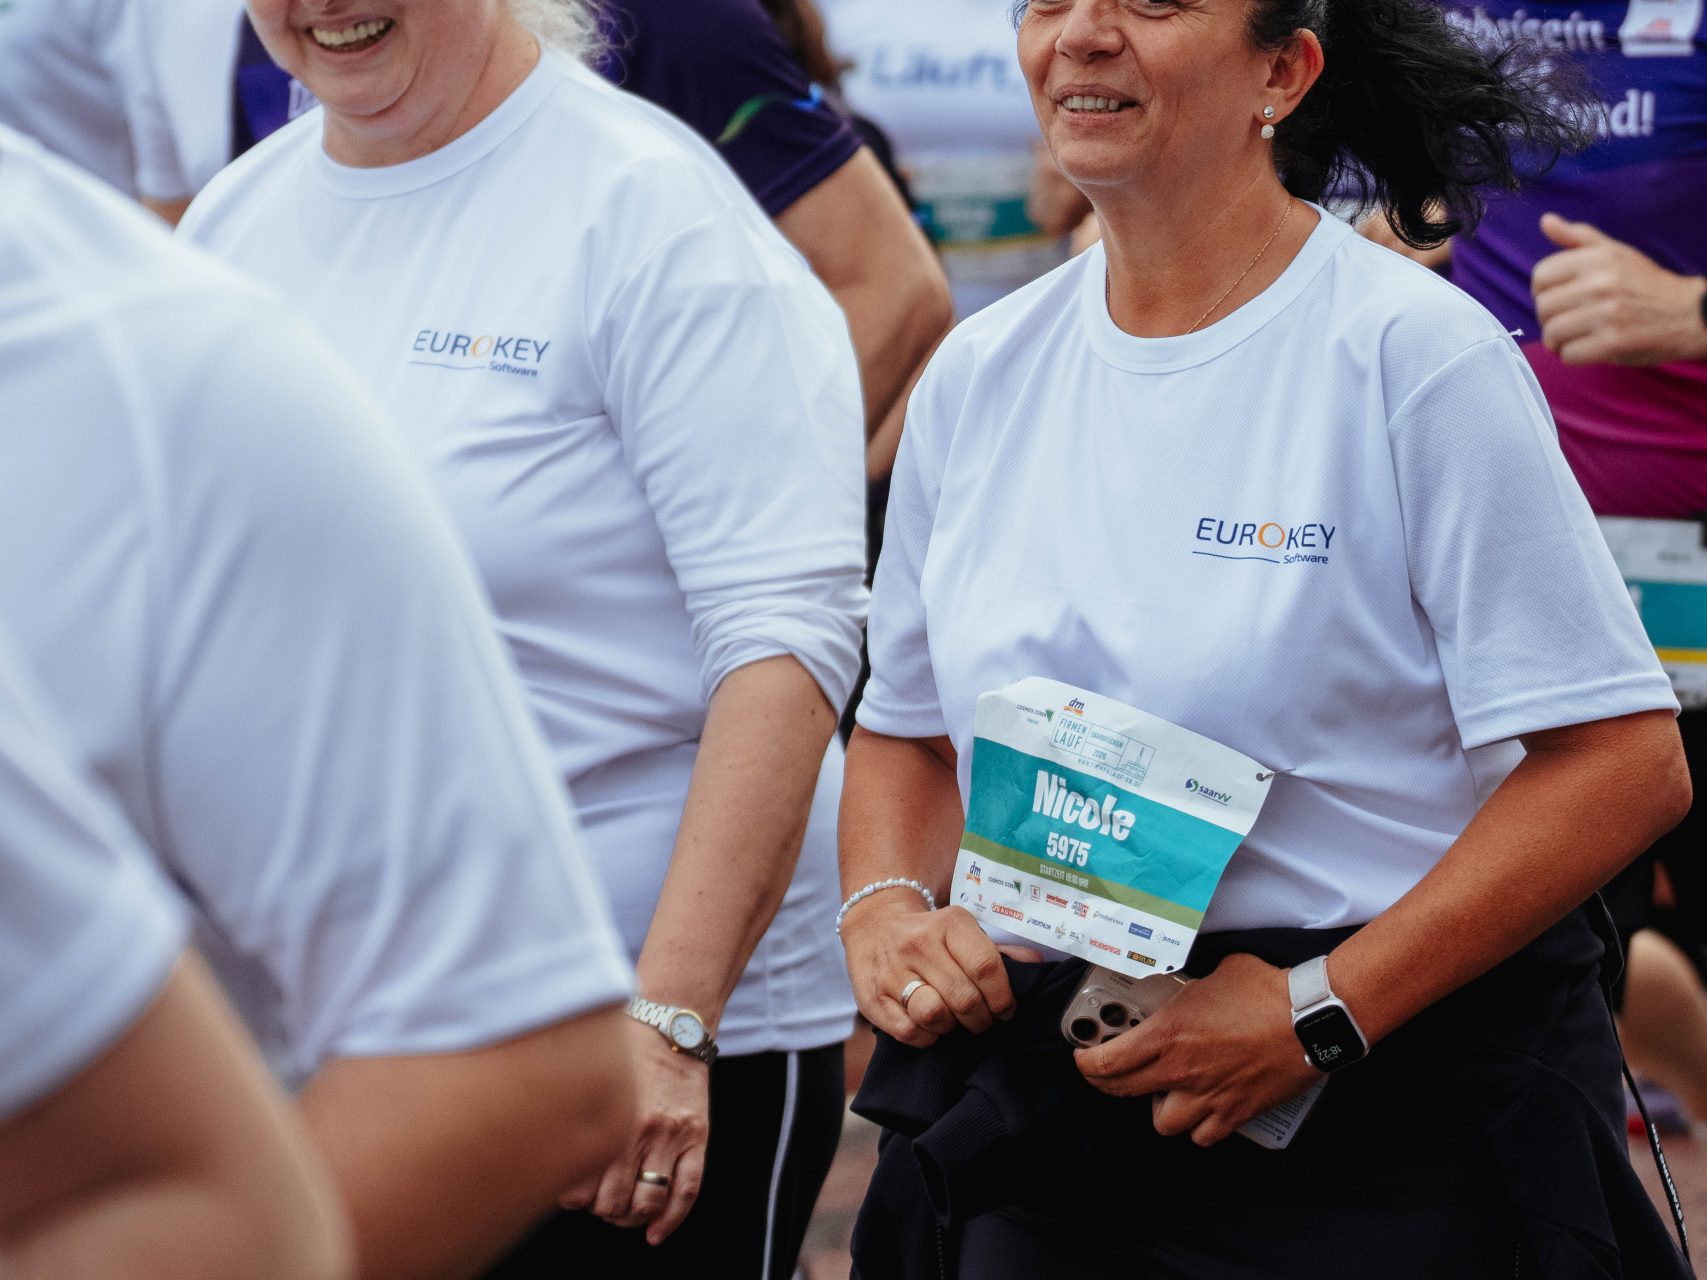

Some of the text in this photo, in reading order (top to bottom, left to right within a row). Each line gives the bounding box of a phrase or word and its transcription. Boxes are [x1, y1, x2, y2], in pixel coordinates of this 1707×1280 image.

[413, 330, 551, 363] EUROKEY
[488, 361, 538, 377] Software
[1195, 517, 1336, 550] EUROKEY
[1283, 554, 1329, 564] Software
[1068, 698, 1085, 710] dm
[1060, 718, 1088, 734] FIRMEN
[1053, 729, 1083, 750] LAUF
[1032, 770, 1136, 841] Nicole
[1046, 832, 1091, 867] 5975
[969, 861, 982, 877] dm
[995, 905, 1024, 921] BAUHAUS
[1127, 951, 1156, 967] FORUM
[1318, 1044, 1342, 1061] 18:22
